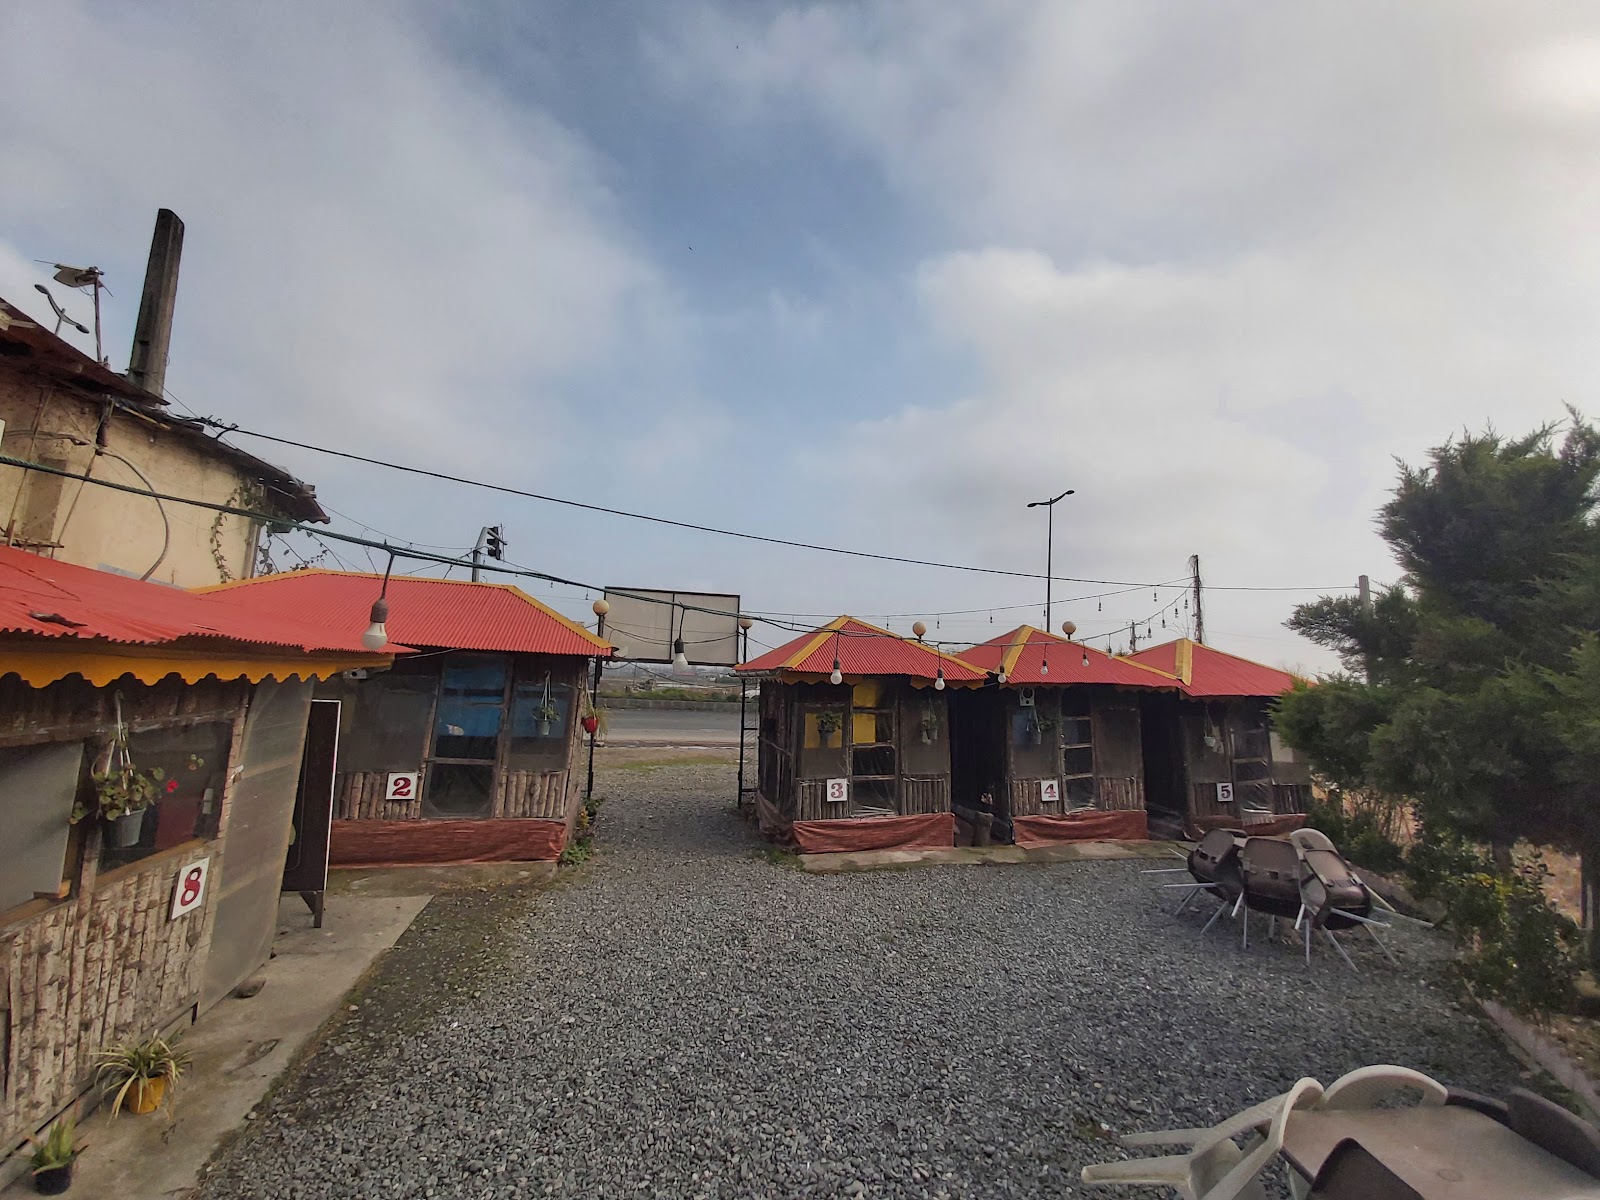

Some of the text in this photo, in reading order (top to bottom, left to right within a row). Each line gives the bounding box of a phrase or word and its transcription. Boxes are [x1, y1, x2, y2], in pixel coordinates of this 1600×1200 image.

[391, 776, 412, 797] 2
[830, 782, 844, 799] 3
[1043, 783, 1057, 799] 4
[1220, 784, 1232, 799] 5
[180, 866, 203, 907] 8
